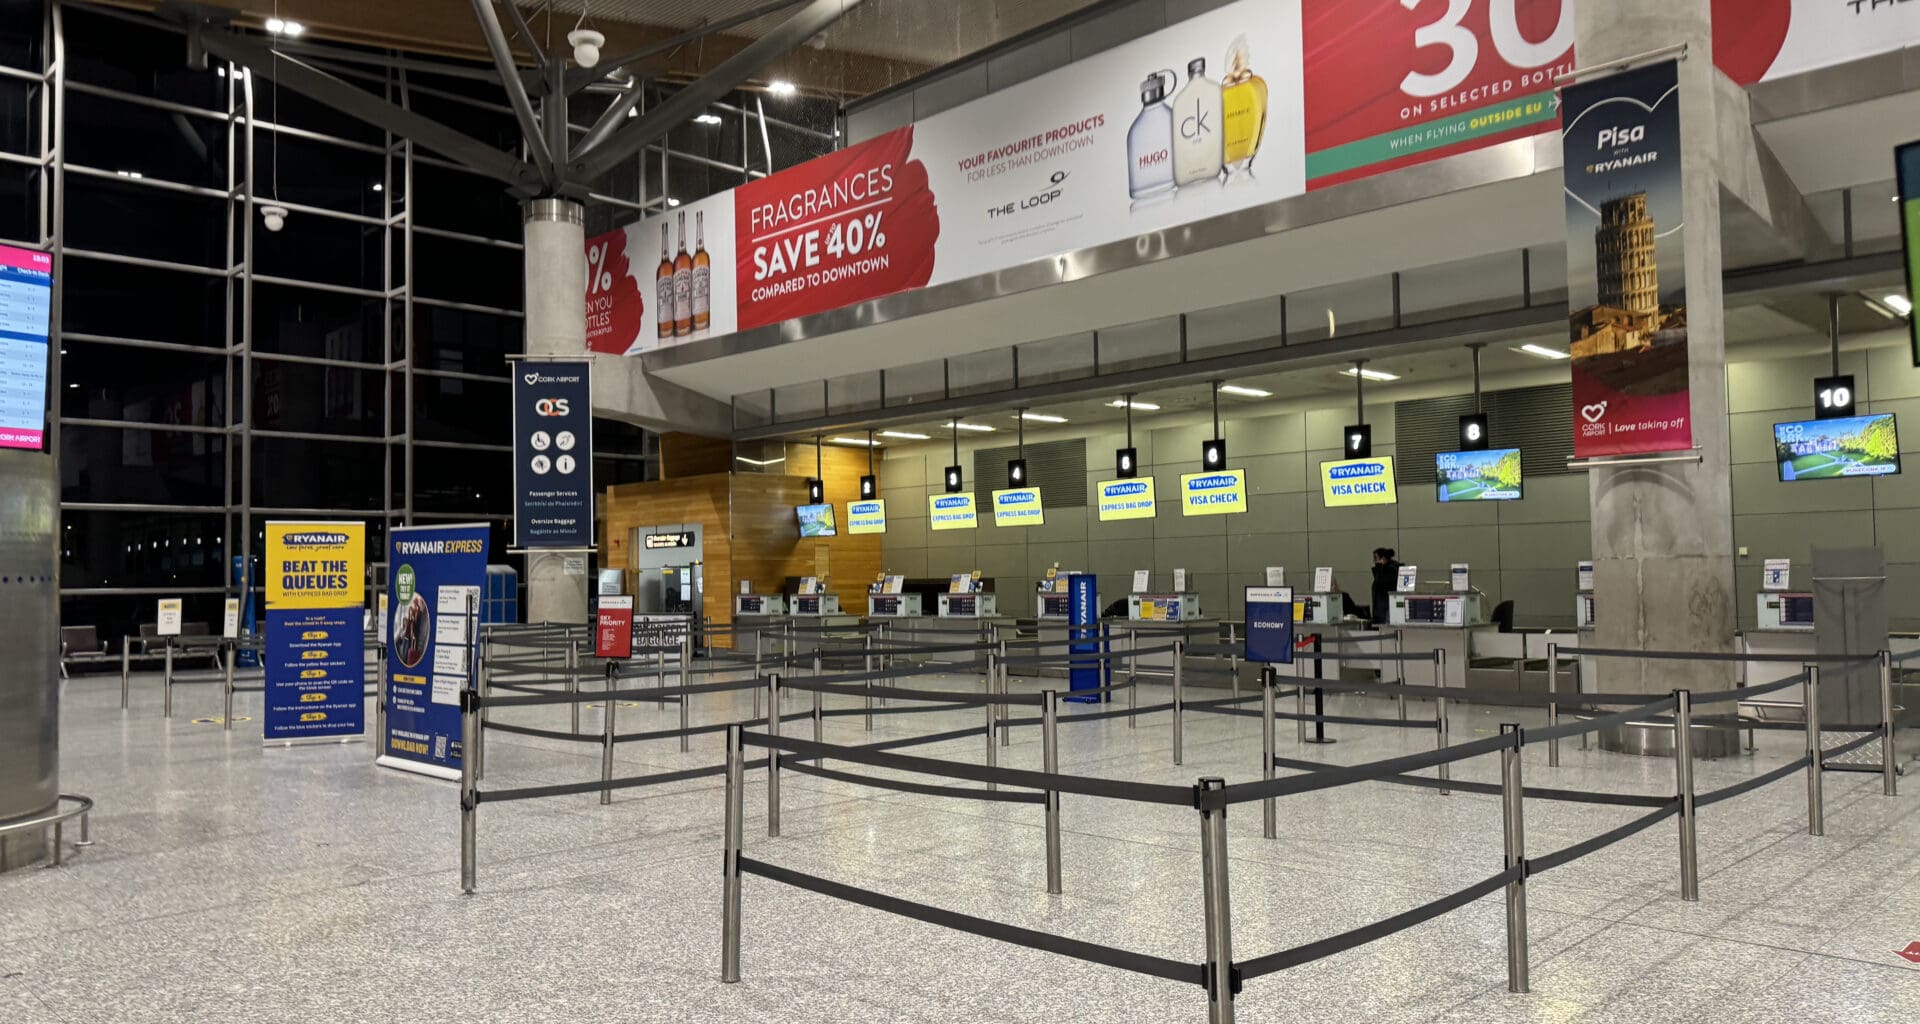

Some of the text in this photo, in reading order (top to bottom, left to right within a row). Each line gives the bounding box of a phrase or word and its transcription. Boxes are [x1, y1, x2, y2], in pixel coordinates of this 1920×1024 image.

[1847, 0, 1914, 14] TH
[1400, 105, 1422, 119] ON
[1430, 80, 1513, 112] SELECTED
[1180, 97, 1210, 139] ck
[1390, 102, 1542, 149] WHEN FLYING OUTSIDE EU
[958, 113, 1105, 172] YOUR FAVOURITE PRODUCTS
[1597, 125, 1645, 150] Pisa
[966, 134, 1094, 184] FOR LESS THAN DOWNTOWN
[1139, 149, 1168, 168] HUGO
[1594, 151, 1658, 174] RYANAIR
[751, 163, 893, 234] FRAGRANCES
[987, 188, 1062, 219] THE LOOP
[753, 229, 820, 281] SAVE
[826, 211, 886, 259] 40%
[751, 254, 889, 302] COMPARED TO DOWNTOWN
[594, 295, 613, 312] YOU
[1820, 387, 1850, 408] 10
[535, 398, 570, 417] OCS
[1467, 424, 1480, 440] 8
[1582, 423, 1606, 432] CORK
[1614, 417, 1684, 433] Love taking off
[1351, 434, 1362, 450] 7
[1208, 448, 1218, 463] 6
[1012, 466, 1021, 480] 4
[1337, 466, 1382, 476] RYANAIR
[1111, 484, 1145, 495] RYANAIR
[1196, 477, 1235, 488] RYANAIR
[1331, 482, 1386, 495] VISA CHECK
[939, 498, 968, 507] RYANAIR
[1003, 494, 1034, 503] RYANAIR
[1101, 501, 1153, 512] EXPRESS BAG DROP
[1189, 493, 1238, 505] VISA CHECK
[932, 514, 953, 522] EXPRESS
[997, 510, 1017, 518] EXPRESS
[293, 535, 346, 543] RYANAIR
[402, 538, 483, 555] RYANAIR EXPRESS
[282, 560, 348, 573] BEAT THE
[282, 575, 348, 590] QUEUES
[1253, 621, 1284, 629] ECONOMY
